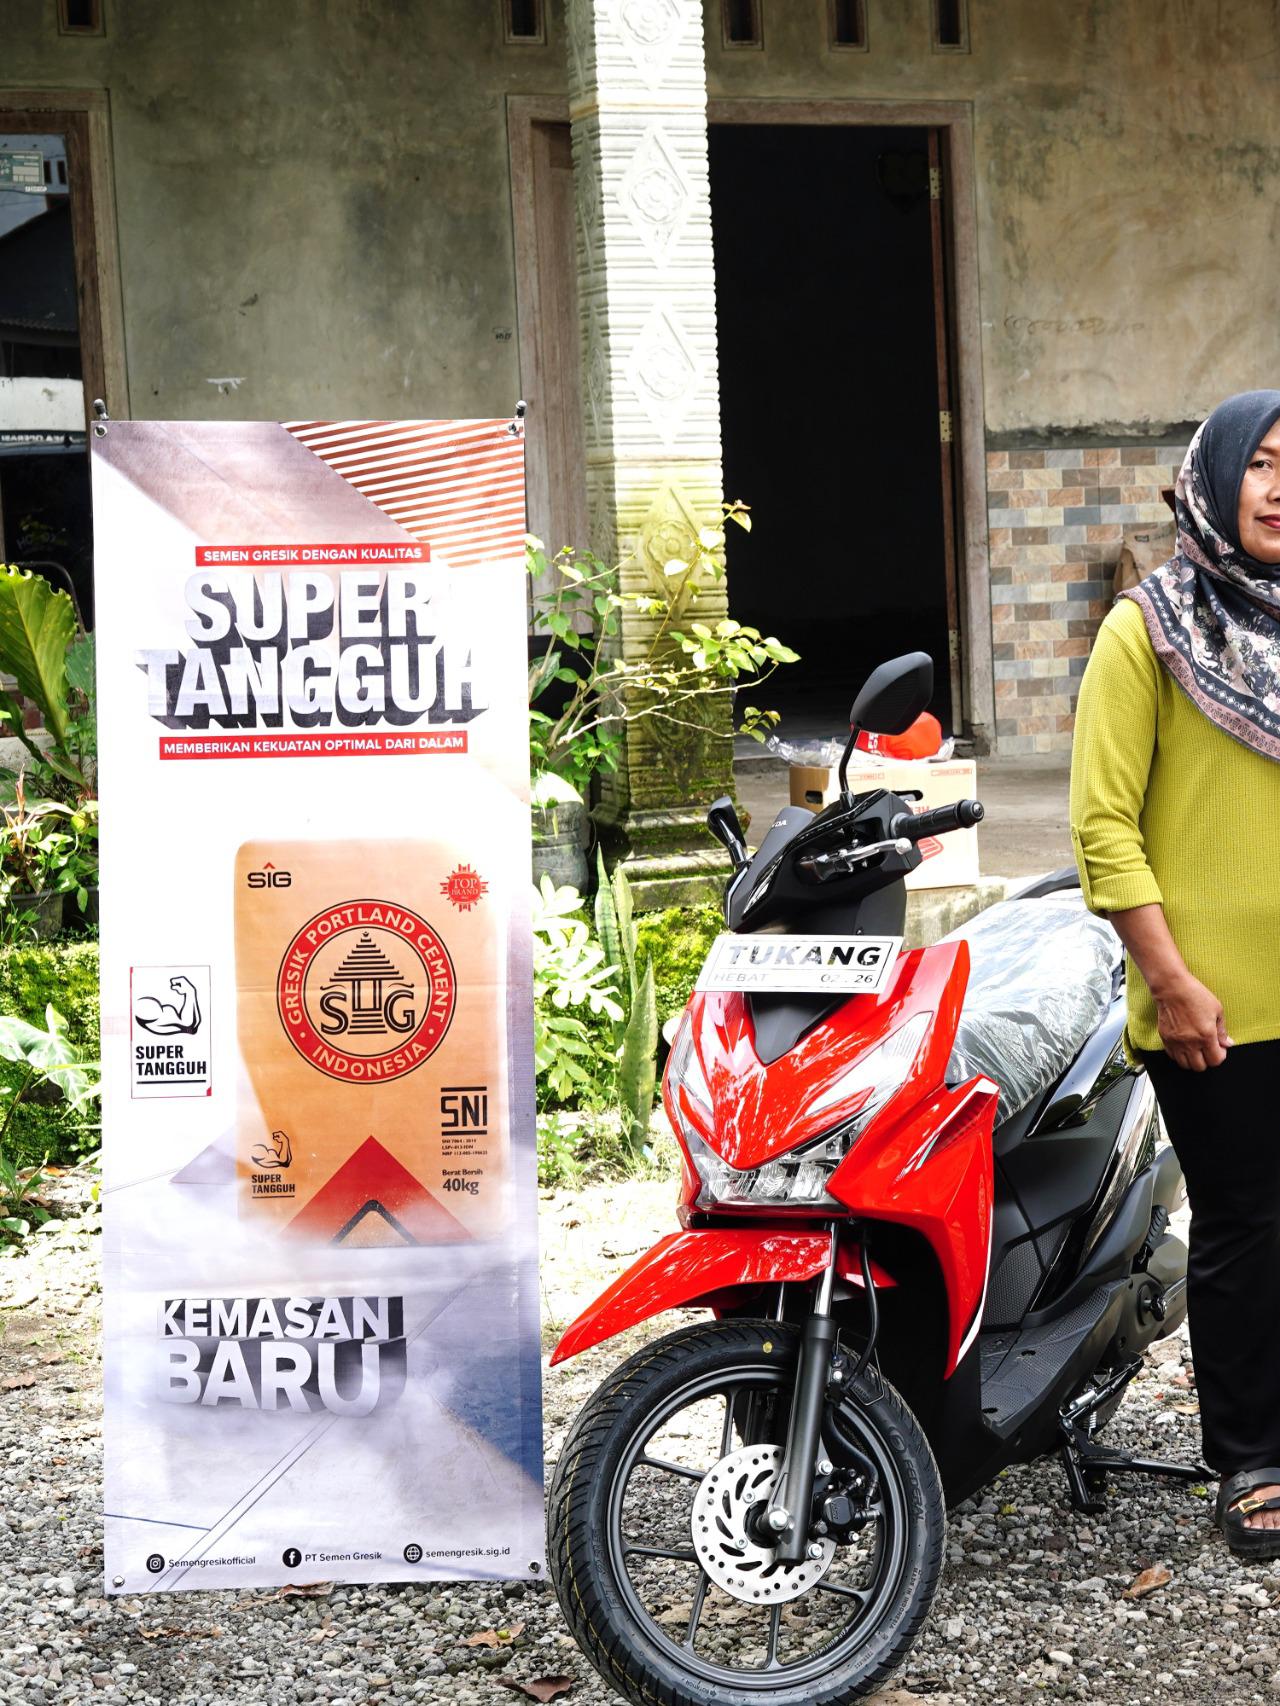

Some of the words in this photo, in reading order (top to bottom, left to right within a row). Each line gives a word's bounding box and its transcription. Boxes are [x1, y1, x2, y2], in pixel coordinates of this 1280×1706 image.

[204, 549, 249, 562] SEMEN
[252, 548, 299, 562] GRESIK
[302, 547, 357, 561] DENGAN
[361, 546, 422, 560] KUALITAS
[184, 570, 437, 644] SUPER
[135, 642, 490, 728] TANGGUH
[164, 740, 250, 754] MEMBERIKAN
[253, 739, 321, 753] KEKUATAN
[324, 738, 382, 751] OPTIMAL
[385, 737, 416, 750] DARI
[419, 736, 464, 750] DALAM
[248, 872, 291, 888] SIG
[454, 878, 477, 889] TOP
[729, 945, 882, 966] TUKANG
[285, 948, 309, 1025] GRESIK
[305, 906, 416, 945] PORTLAND
[417, 934, 449, 1023] CEMENT
[136, 1045, 184, 1060] SUPER
[312, 1042, 427, 1077] INDONESIA
[136, 1061, 207, 1076] TANGGUH
[441, 1095, 487, 1127] SNI
[252, 1174, 281, 1184] SUPER
[462, 1168, 483, 1176] Bersih
[252, 1184, 295, 1193] TANGGUH
[443, 1178, 479, 1195] 40kg
[160, 1298, 398, 1340] KEMASAN
[158, 1338, 388, 1418] BARU
[903, 1458, 925, 1524] FEDERAL
[305, 1554, 316, 1562] PT
[319, 1553, 350, 1562] Semen
[352, 1551, 382, 1561] Gresik
[425, 1547, 510, 1559] semengresik.sig.id
[169, 1556, 256, 1568] Semengresikofficial
